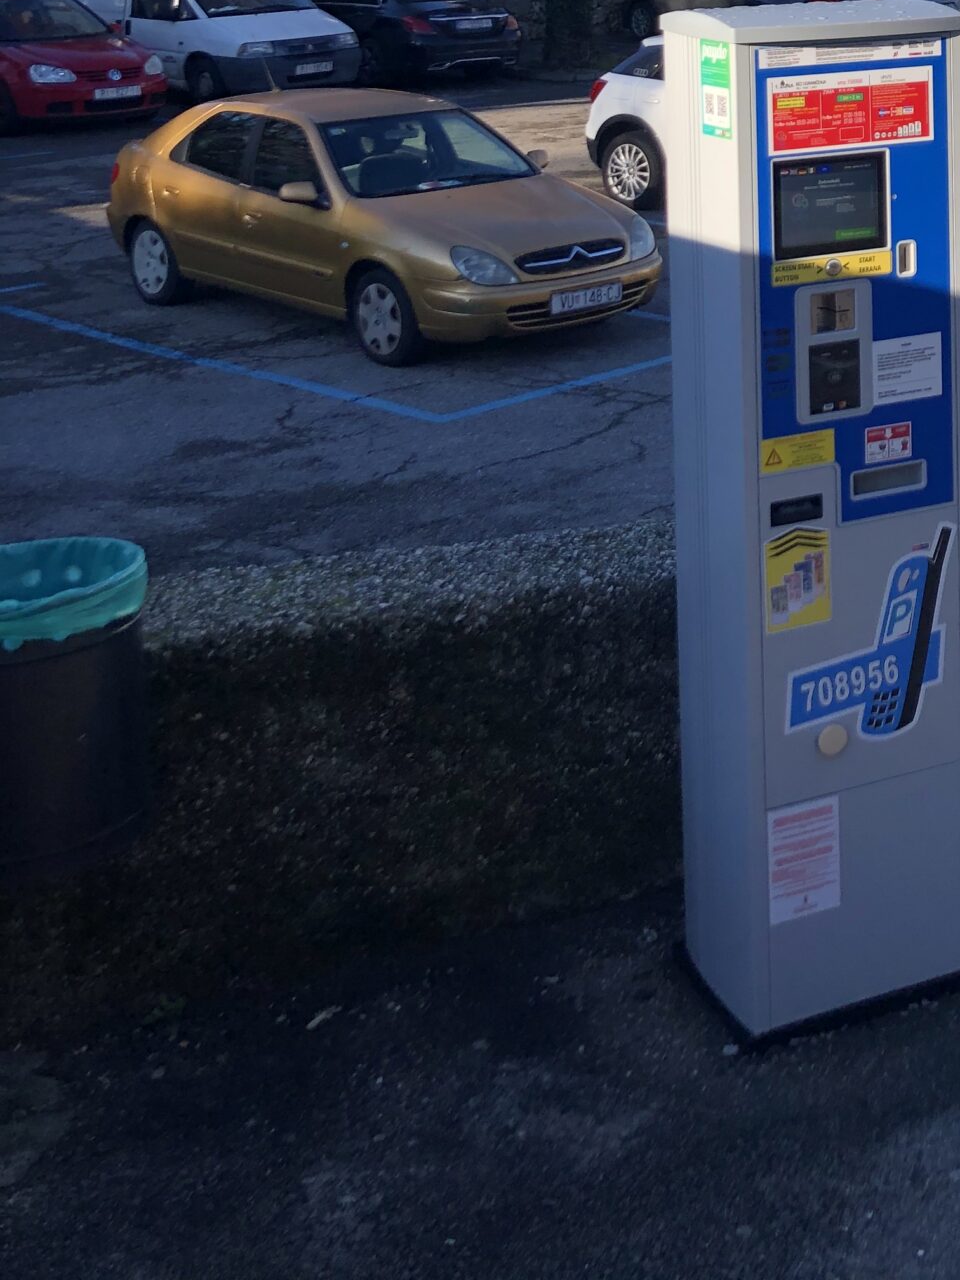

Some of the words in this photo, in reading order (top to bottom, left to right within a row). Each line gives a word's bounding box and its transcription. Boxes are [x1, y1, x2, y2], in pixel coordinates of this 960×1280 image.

[859, 255, 876, 264] START
[774, 263, 797, 273] SCREEN
[797, 262, 816, 271] START
[859, 264, 882, 274] EKRANA
[774, 274, 800, 283] BUTTON
[560, 293, 575, 309] VU
[886, 599, 913, 637] P
[800, 654, 899, 712] 708956
